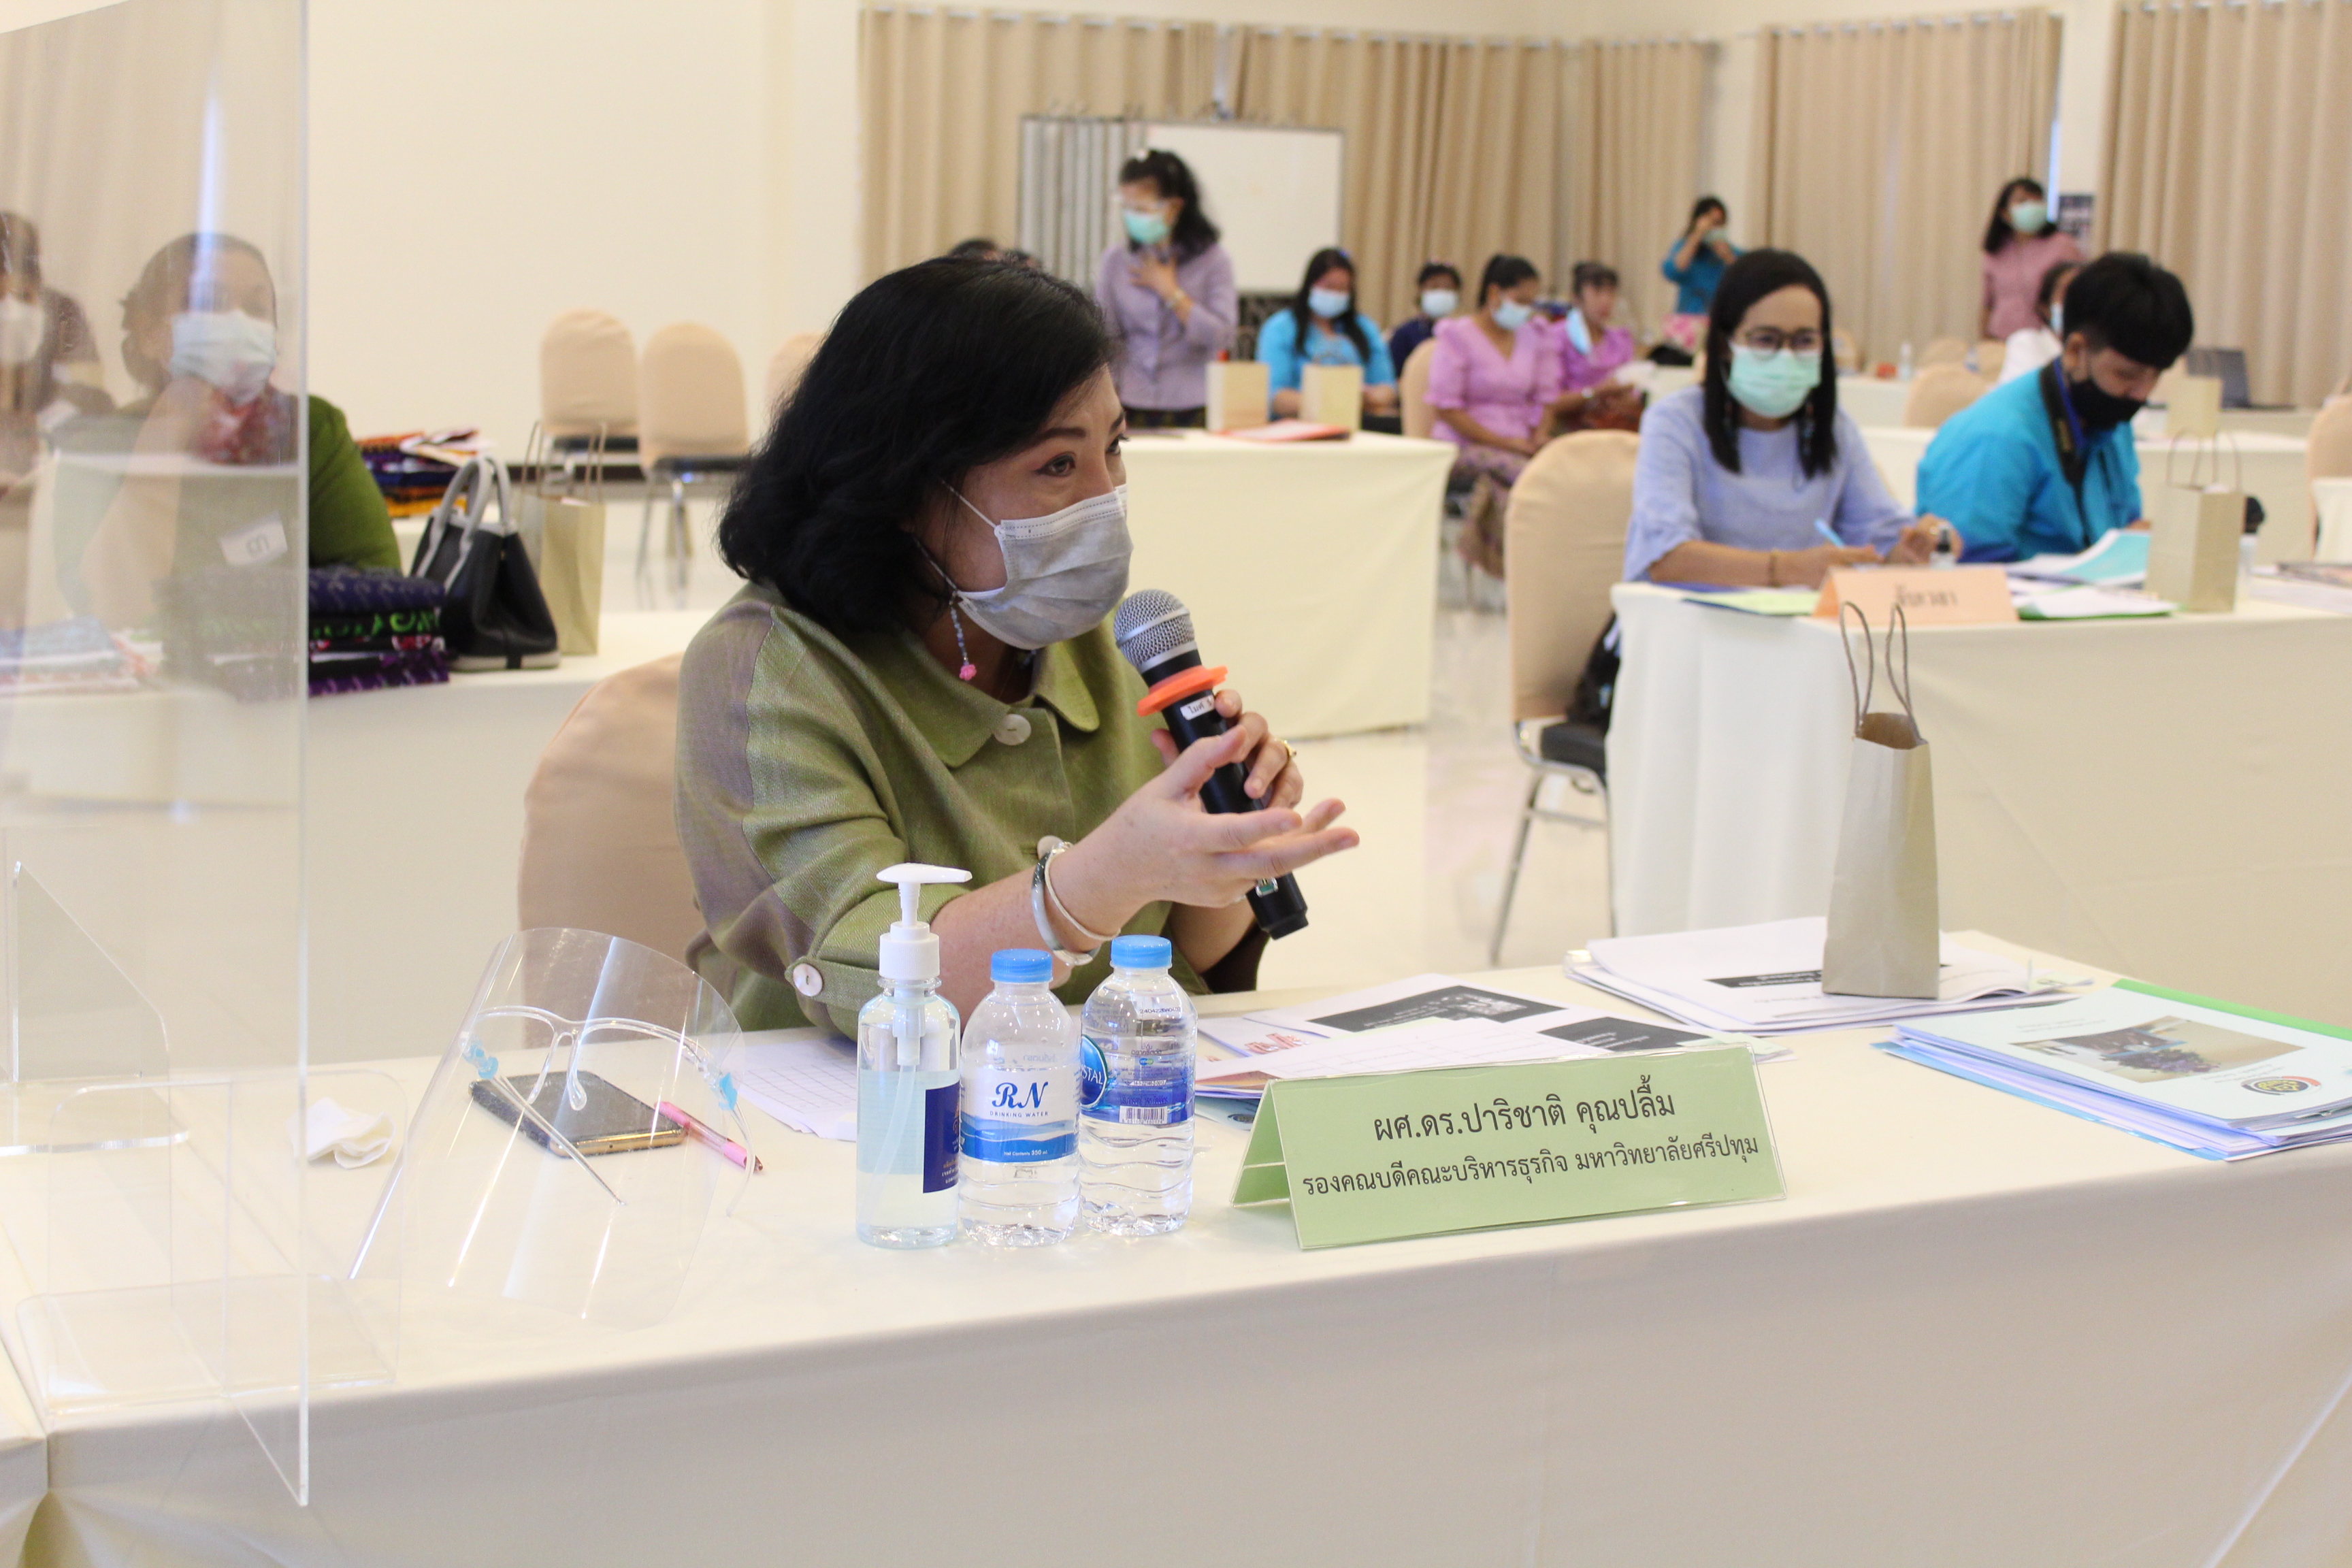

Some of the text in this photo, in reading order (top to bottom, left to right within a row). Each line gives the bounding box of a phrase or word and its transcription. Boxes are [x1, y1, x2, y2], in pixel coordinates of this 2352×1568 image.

[992, 1081, 1049, 1109] RN
[1374, 1075, 1676, 1141] ผศ.ดร.ปาริชาติ คุณปลื้ม
[1303, 1132, 1759, 1195] รองคณบดีคณะบริหารธุรกิจ มหาวิทยาลัยศรีปทุม
